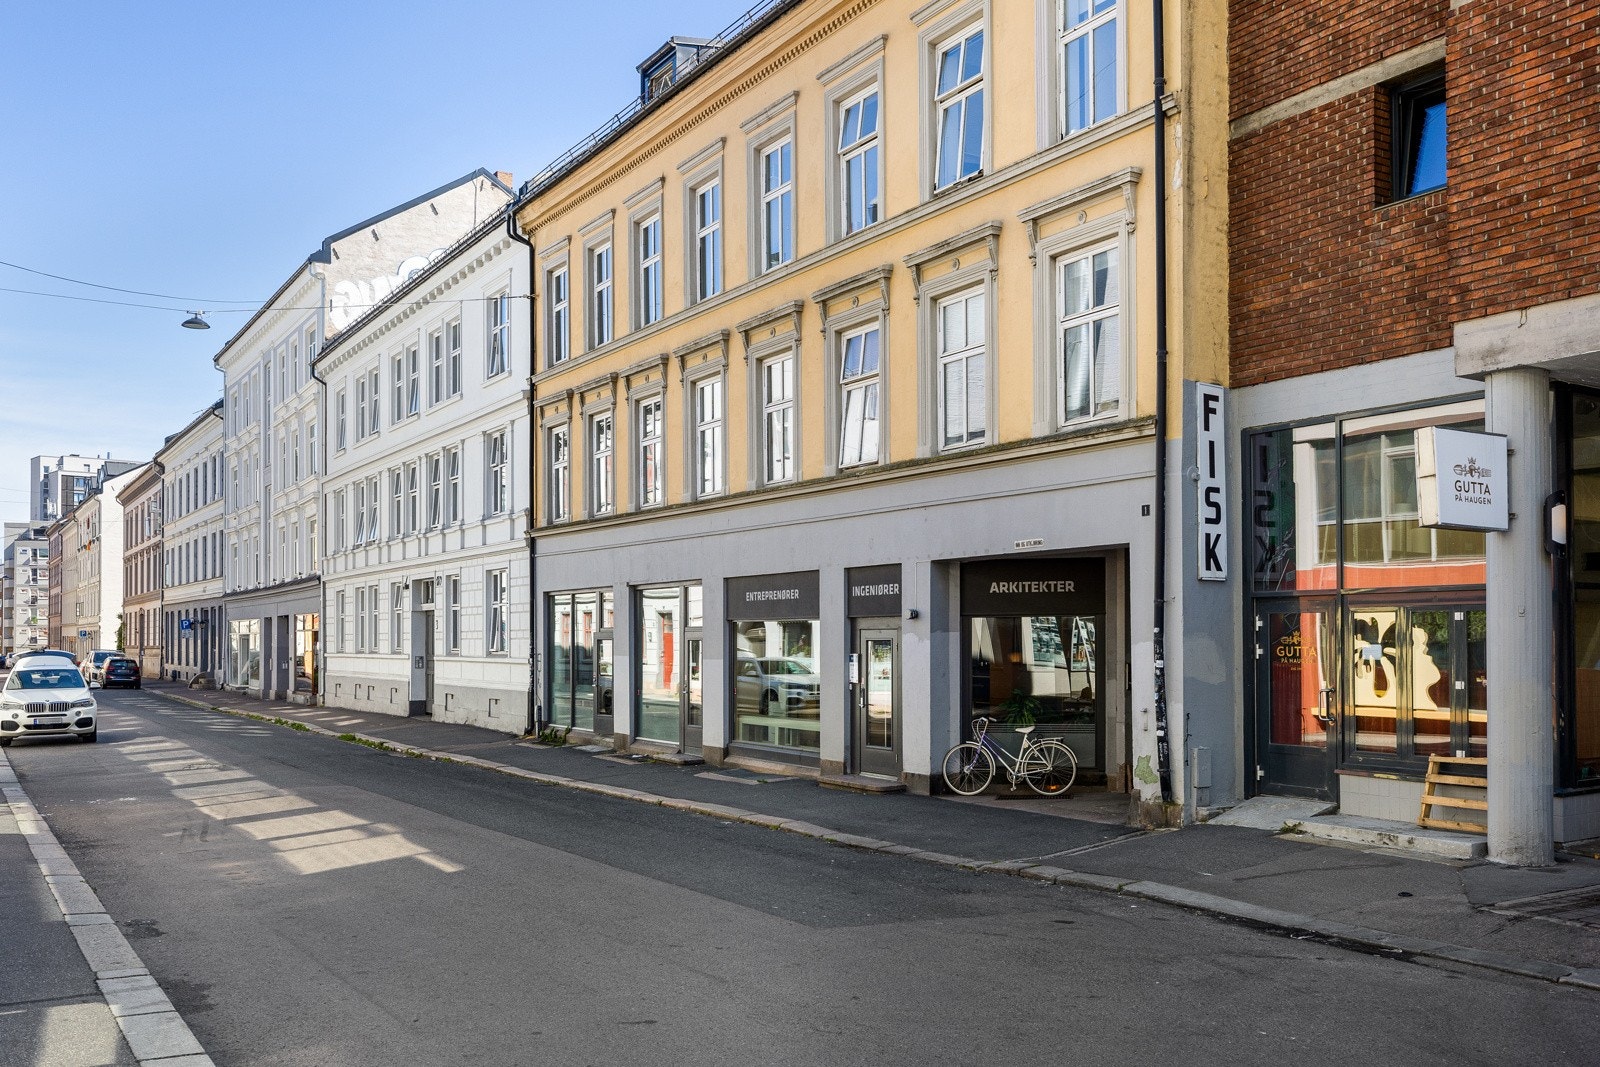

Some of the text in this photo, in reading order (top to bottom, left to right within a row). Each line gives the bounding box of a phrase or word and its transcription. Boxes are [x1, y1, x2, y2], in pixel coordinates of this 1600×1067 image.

[1203, 393, 1223, 571] FISK
[1454, 480, 1491, 495] GUTTA
[1455, 493, 1492, 505] PÅ HAUGEN
[852, 583, 900, 597] INGENIØRER
[989, 581, 1075, 594] ARKITEKTER
[745, 589, 800, 601] ENTREPRENØRER
[1276, 646, 1317, 657] GUTTA
